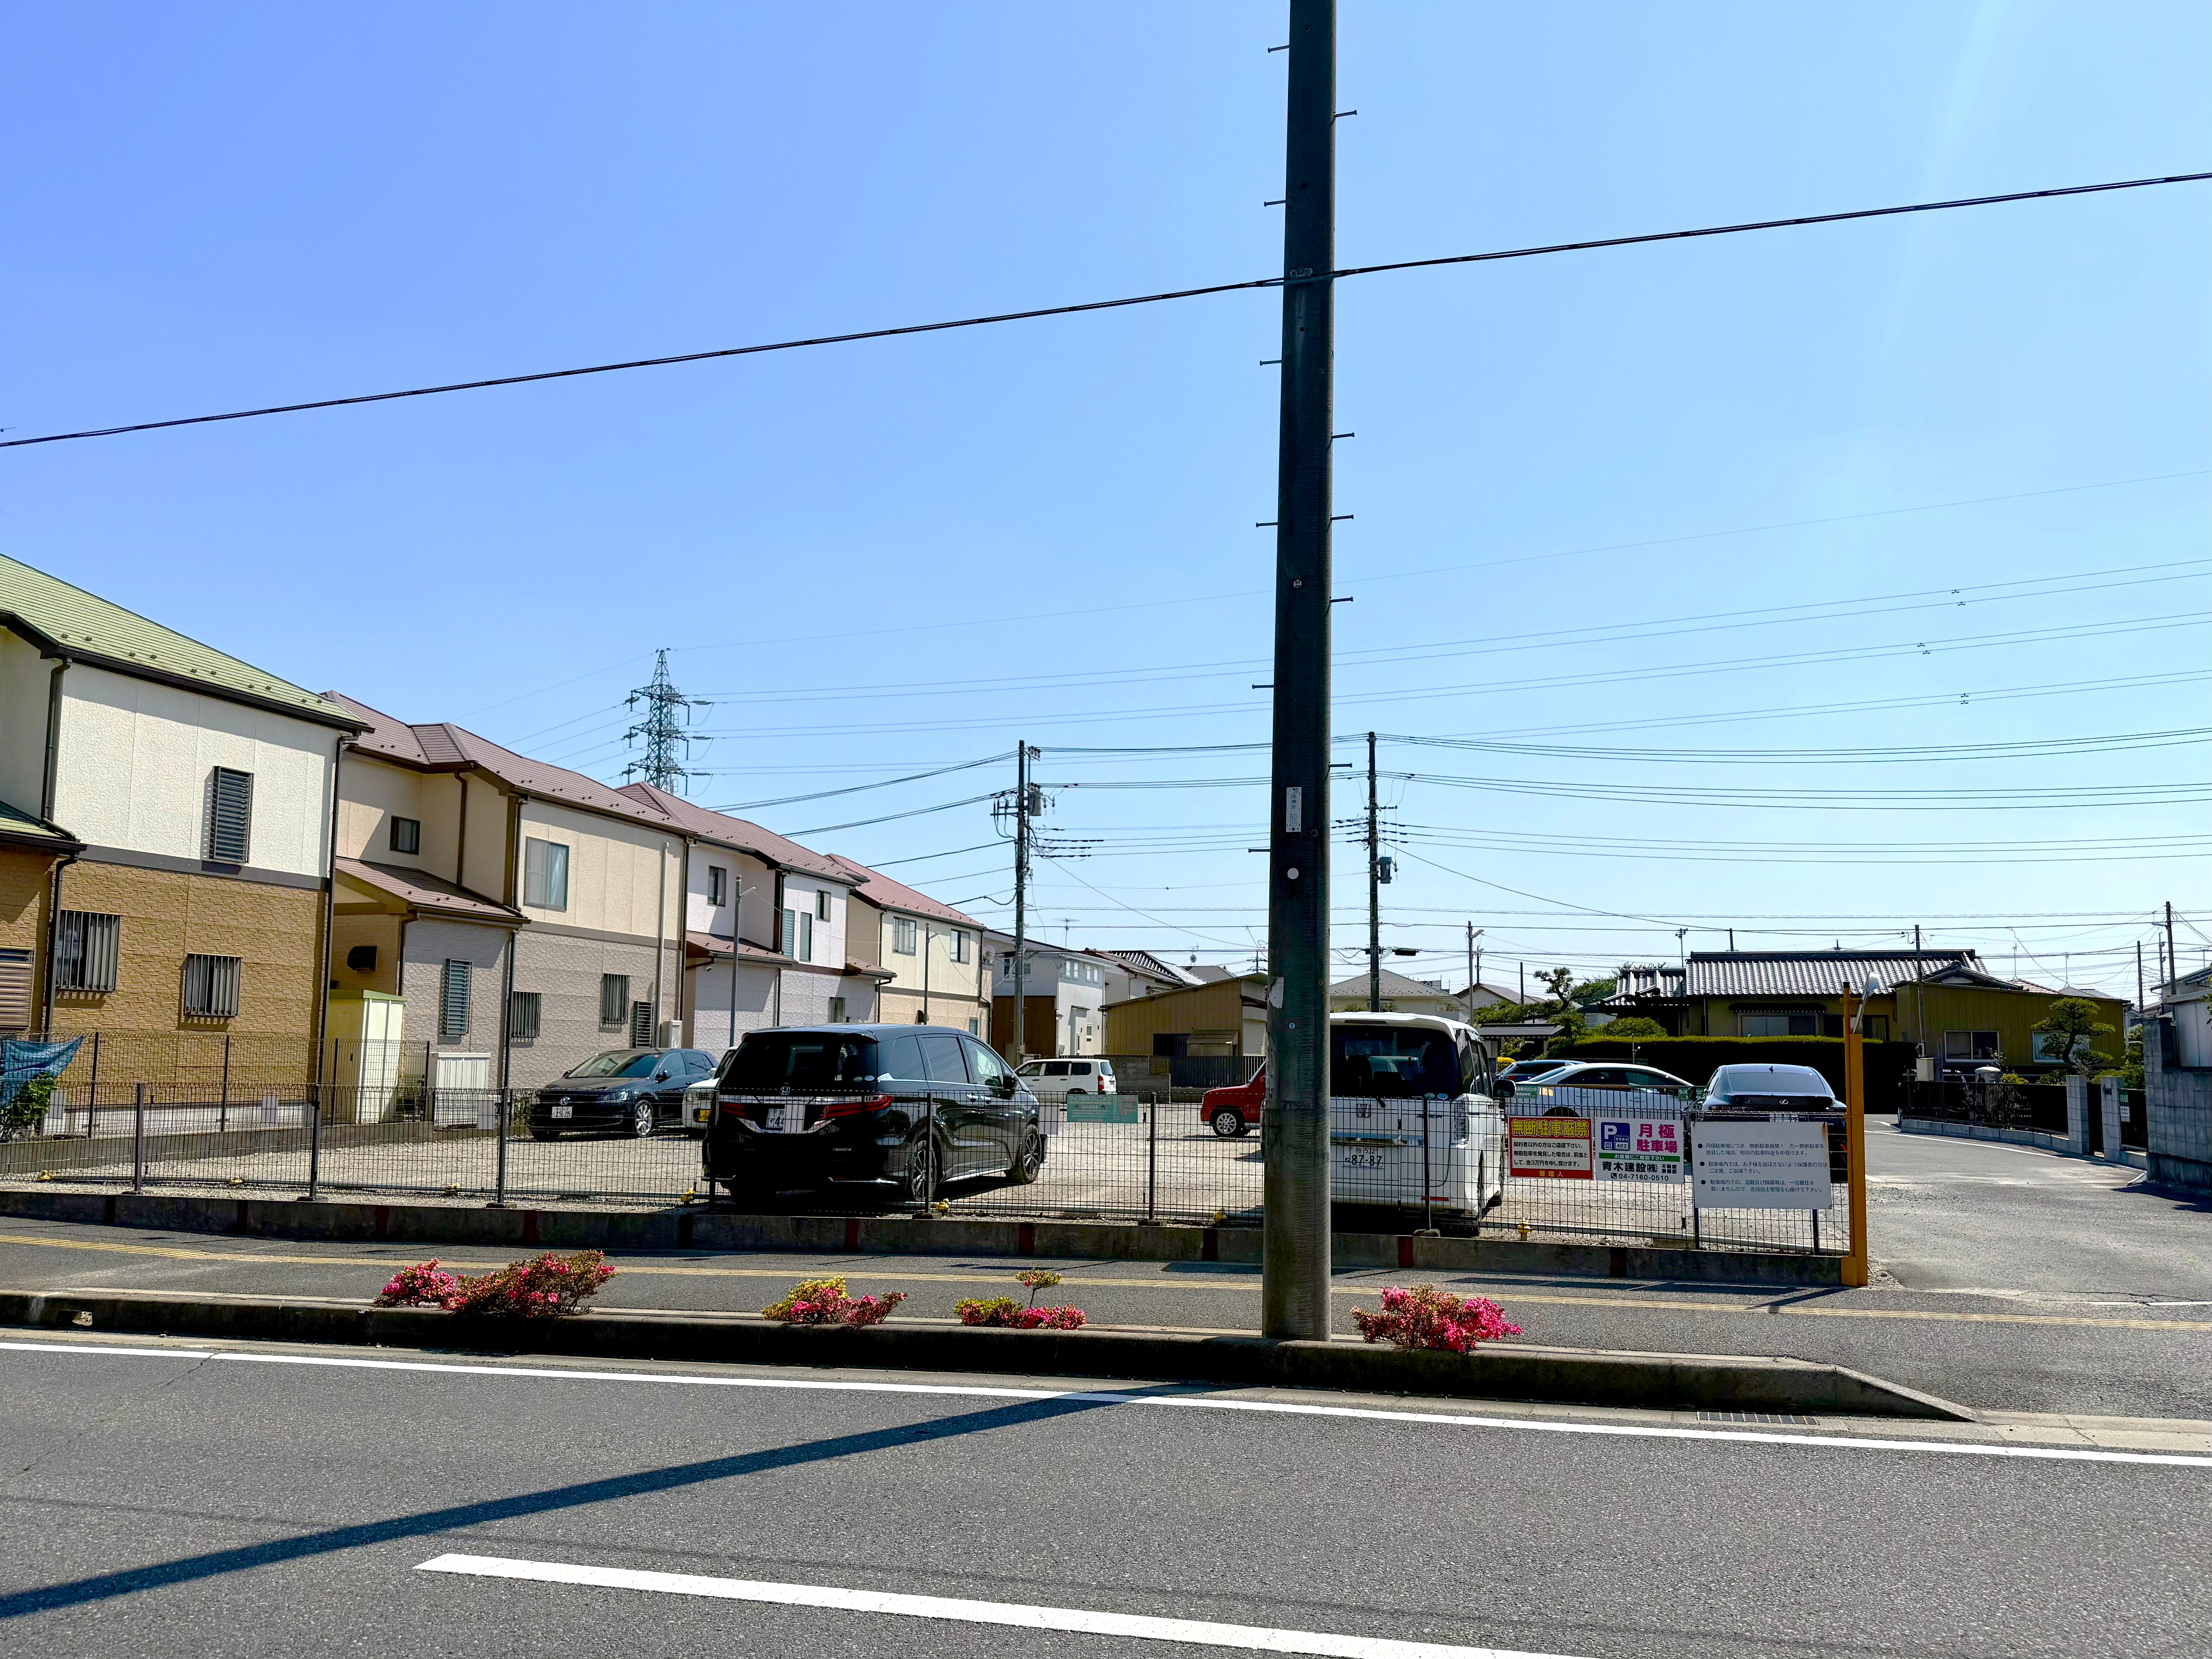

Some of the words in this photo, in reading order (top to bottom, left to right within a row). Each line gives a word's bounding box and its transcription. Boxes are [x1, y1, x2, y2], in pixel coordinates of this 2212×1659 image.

[1512, 1120, 1588, 1137] 無断駐車厳禁
[1604, 1125, 1617, 1139] P
[1639, 1124, 1675, 1138] 月極
[1637, 1139, 1677, 1153] 駐車場
[1351, 1154, 1382, 1166] 87-87
